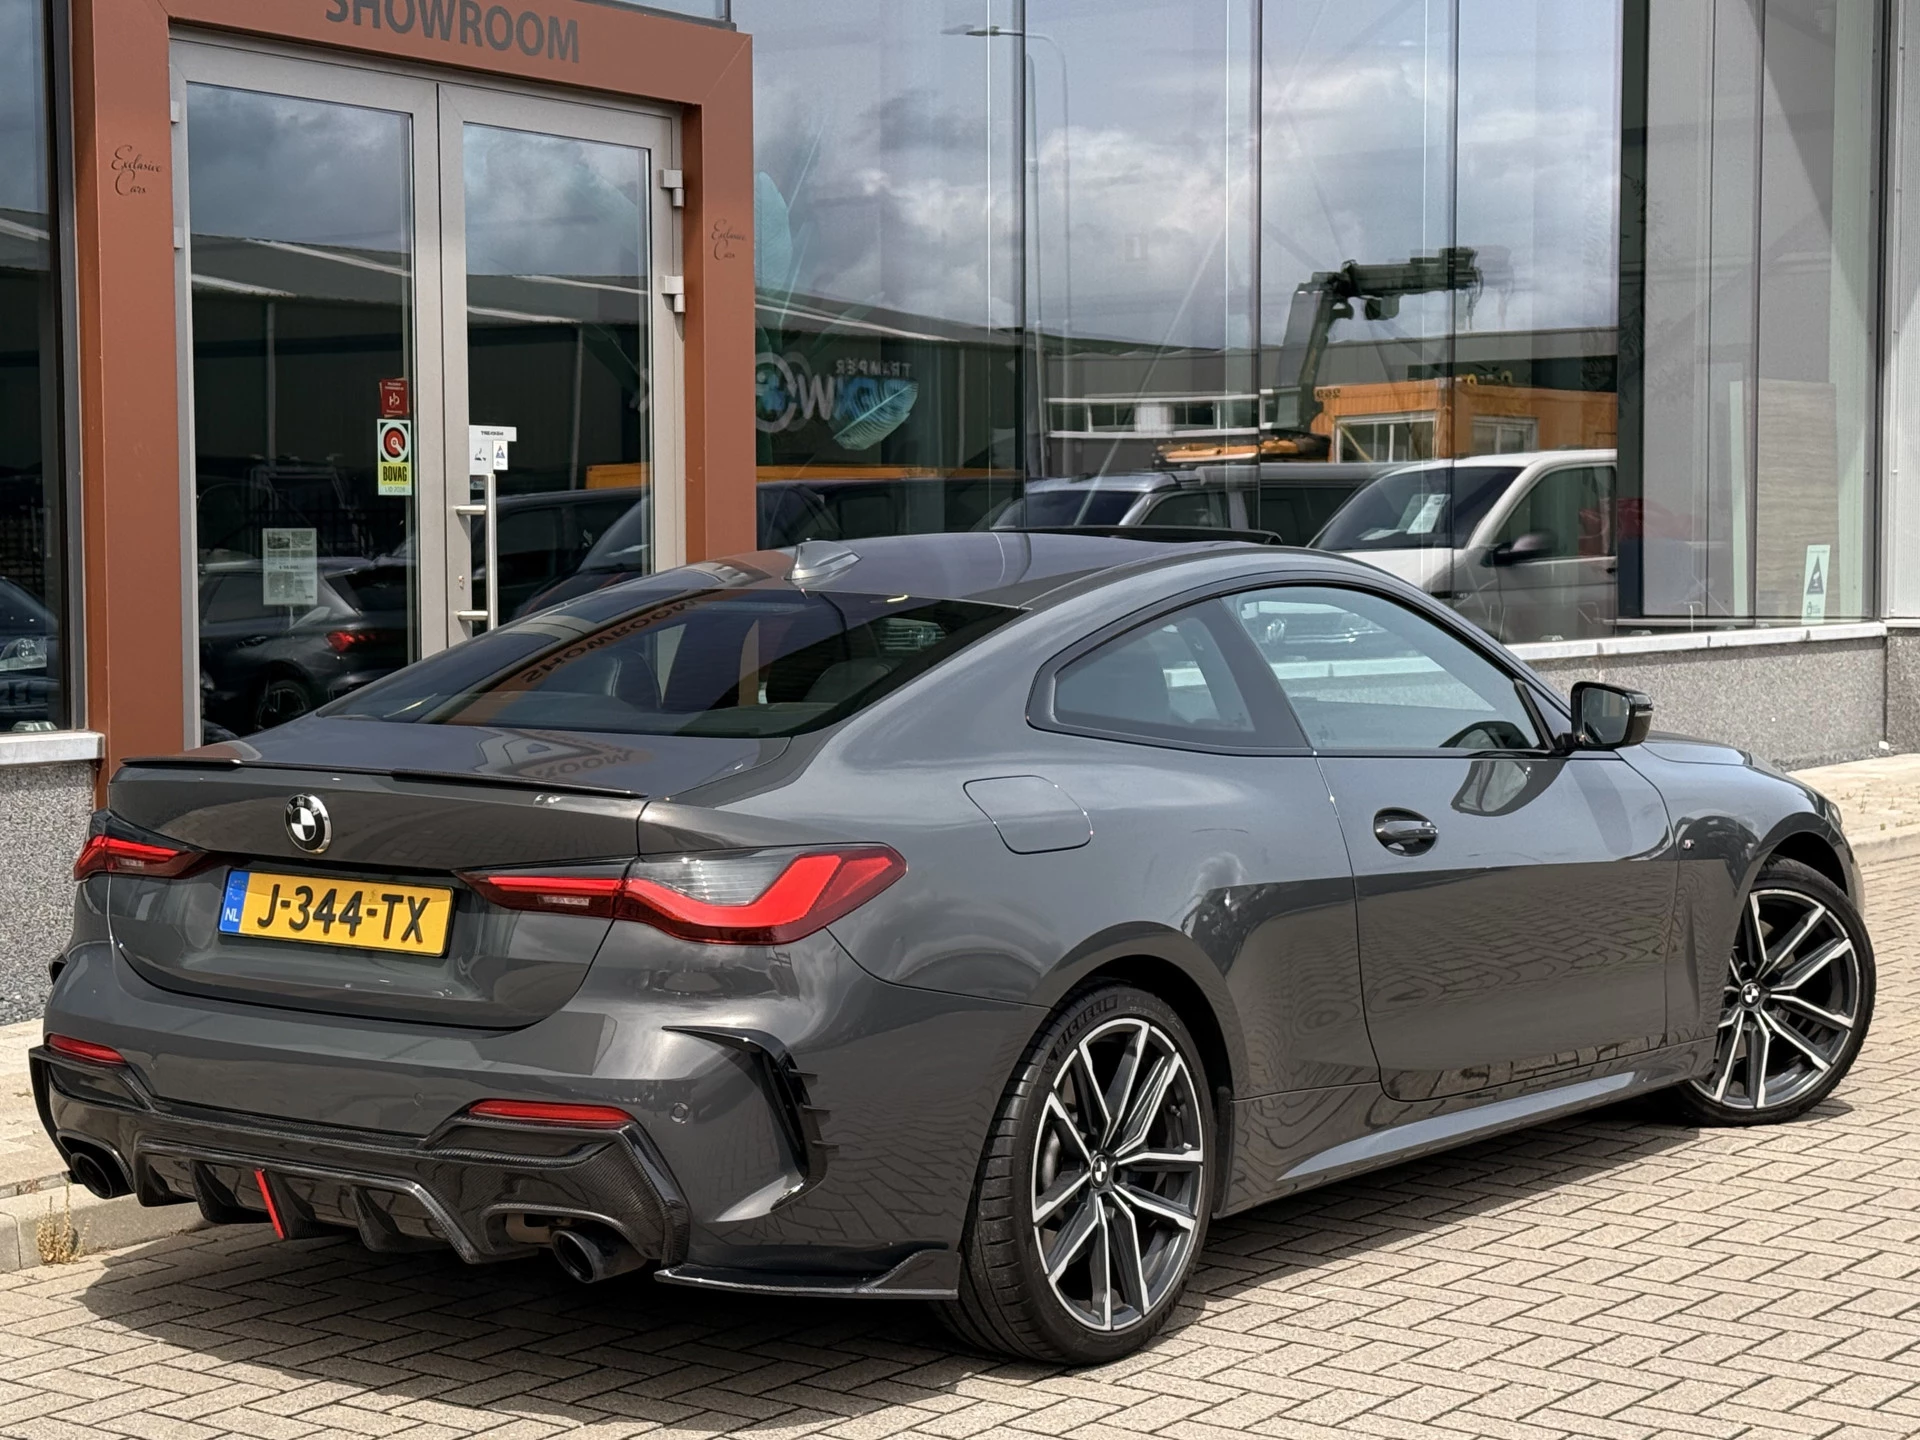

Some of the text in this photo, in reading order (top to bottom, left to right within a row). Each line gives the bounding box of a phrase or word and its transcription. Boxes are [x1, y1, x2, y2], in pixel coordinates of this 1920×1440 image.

[382, 465, 407, 482] BOVAG
[224, 907, 239, 922] NL
[257, 883, 431, 944] J-344-TX
